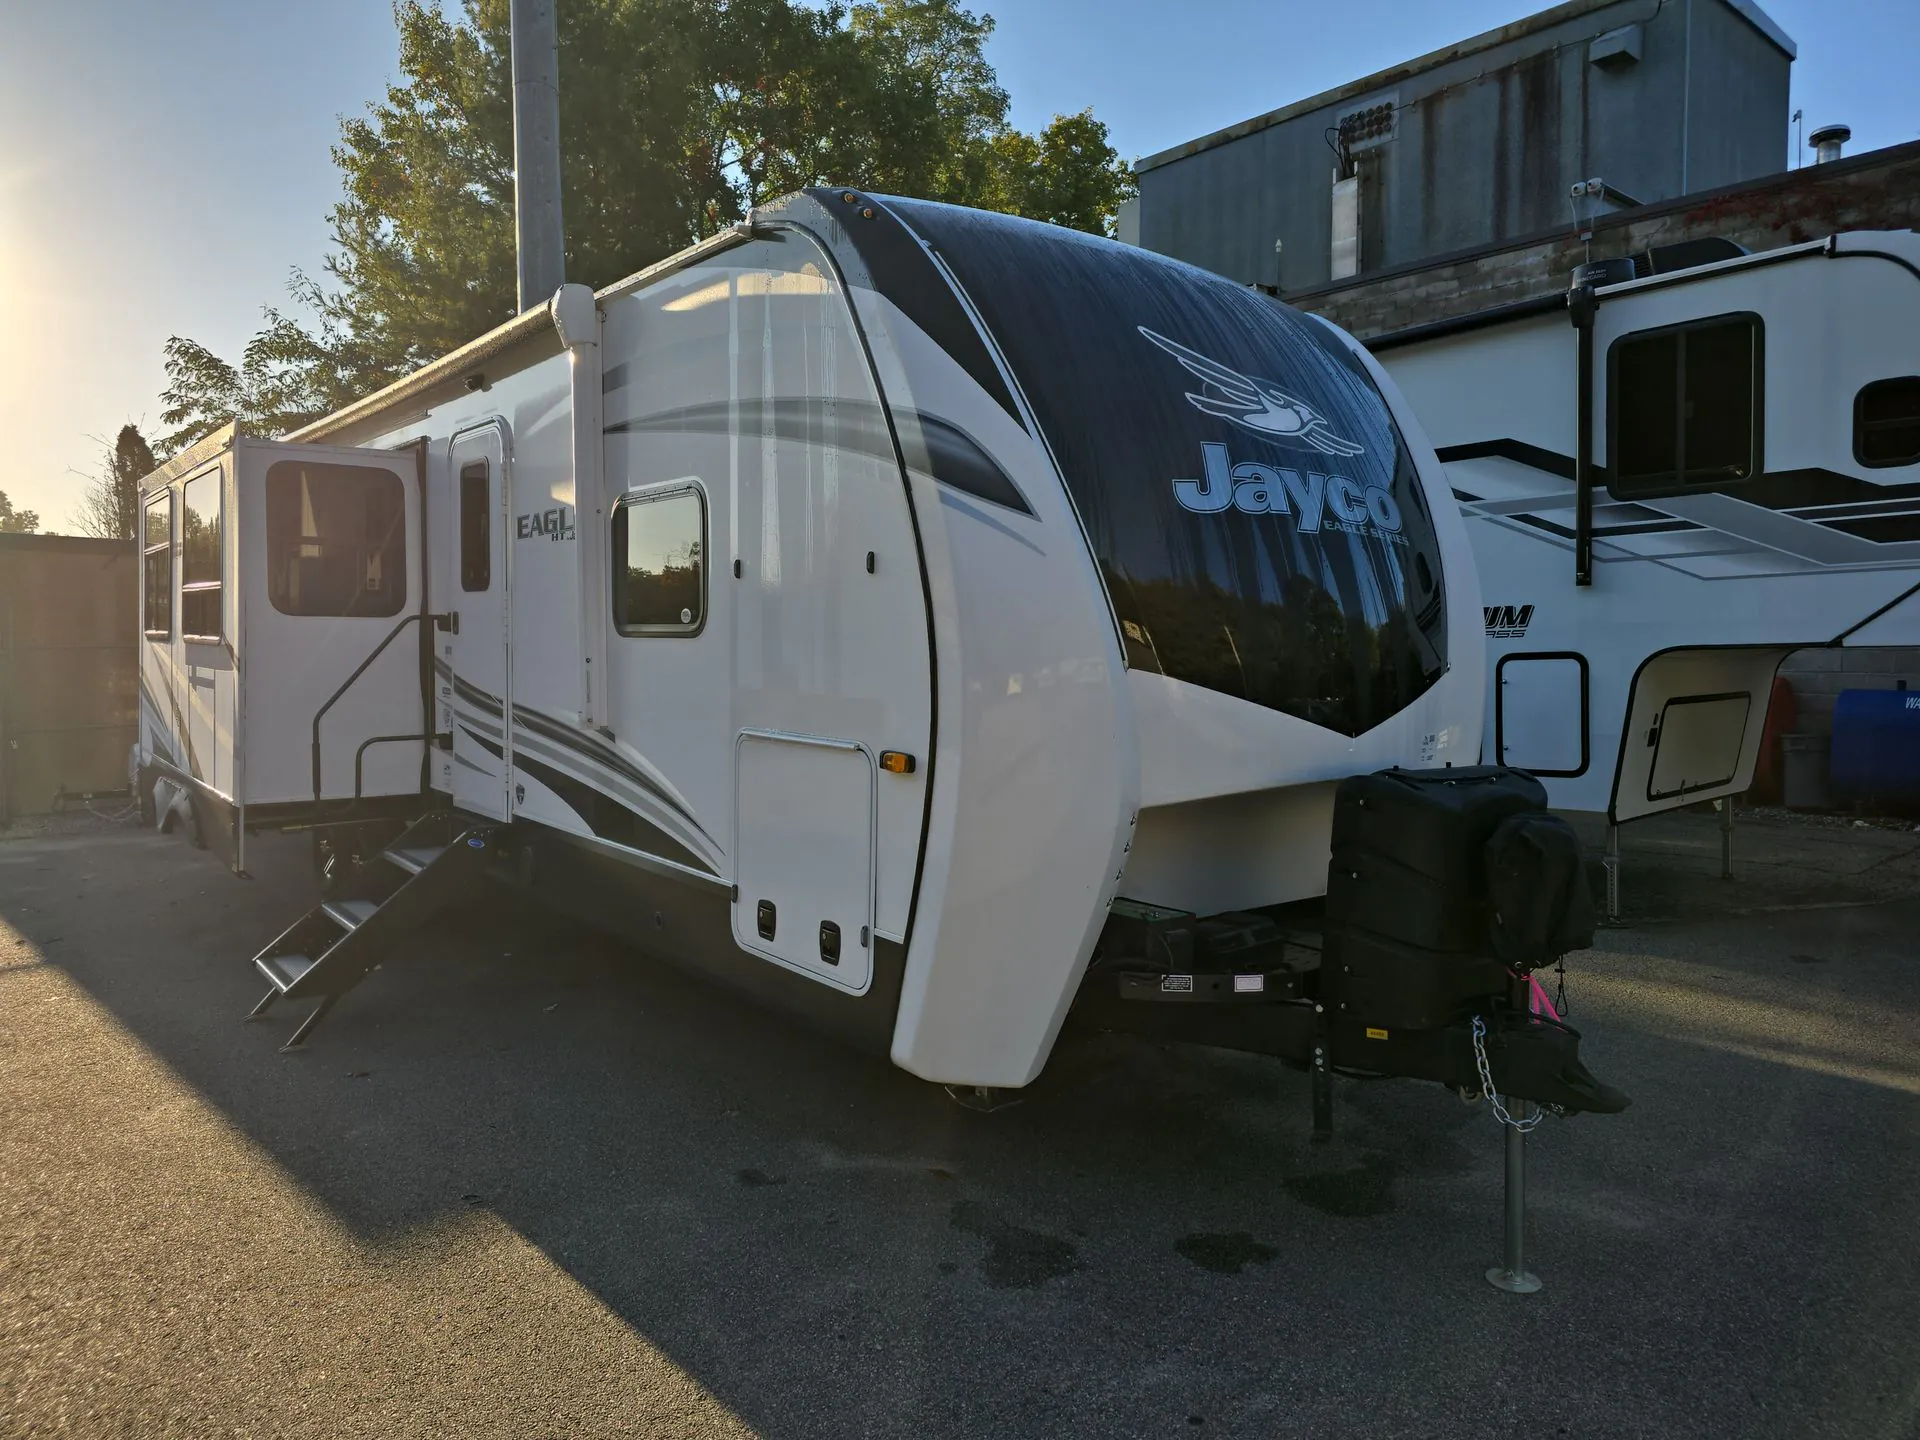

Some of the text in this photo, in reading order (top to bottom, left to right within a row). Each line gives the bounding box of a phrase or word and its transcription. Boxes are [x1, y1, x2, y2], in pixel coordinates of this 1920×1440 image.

[1172, 441, 1403, 534] Jayco
[516, 507, 575, 539] EAGL
[1322, 520, 1410, 546] EAGLE SERIES
[1483, 604, 1535, 629] UM
[1485, 630, 1527, 639] ASS
[1905, 697, 1920, 709] WA
